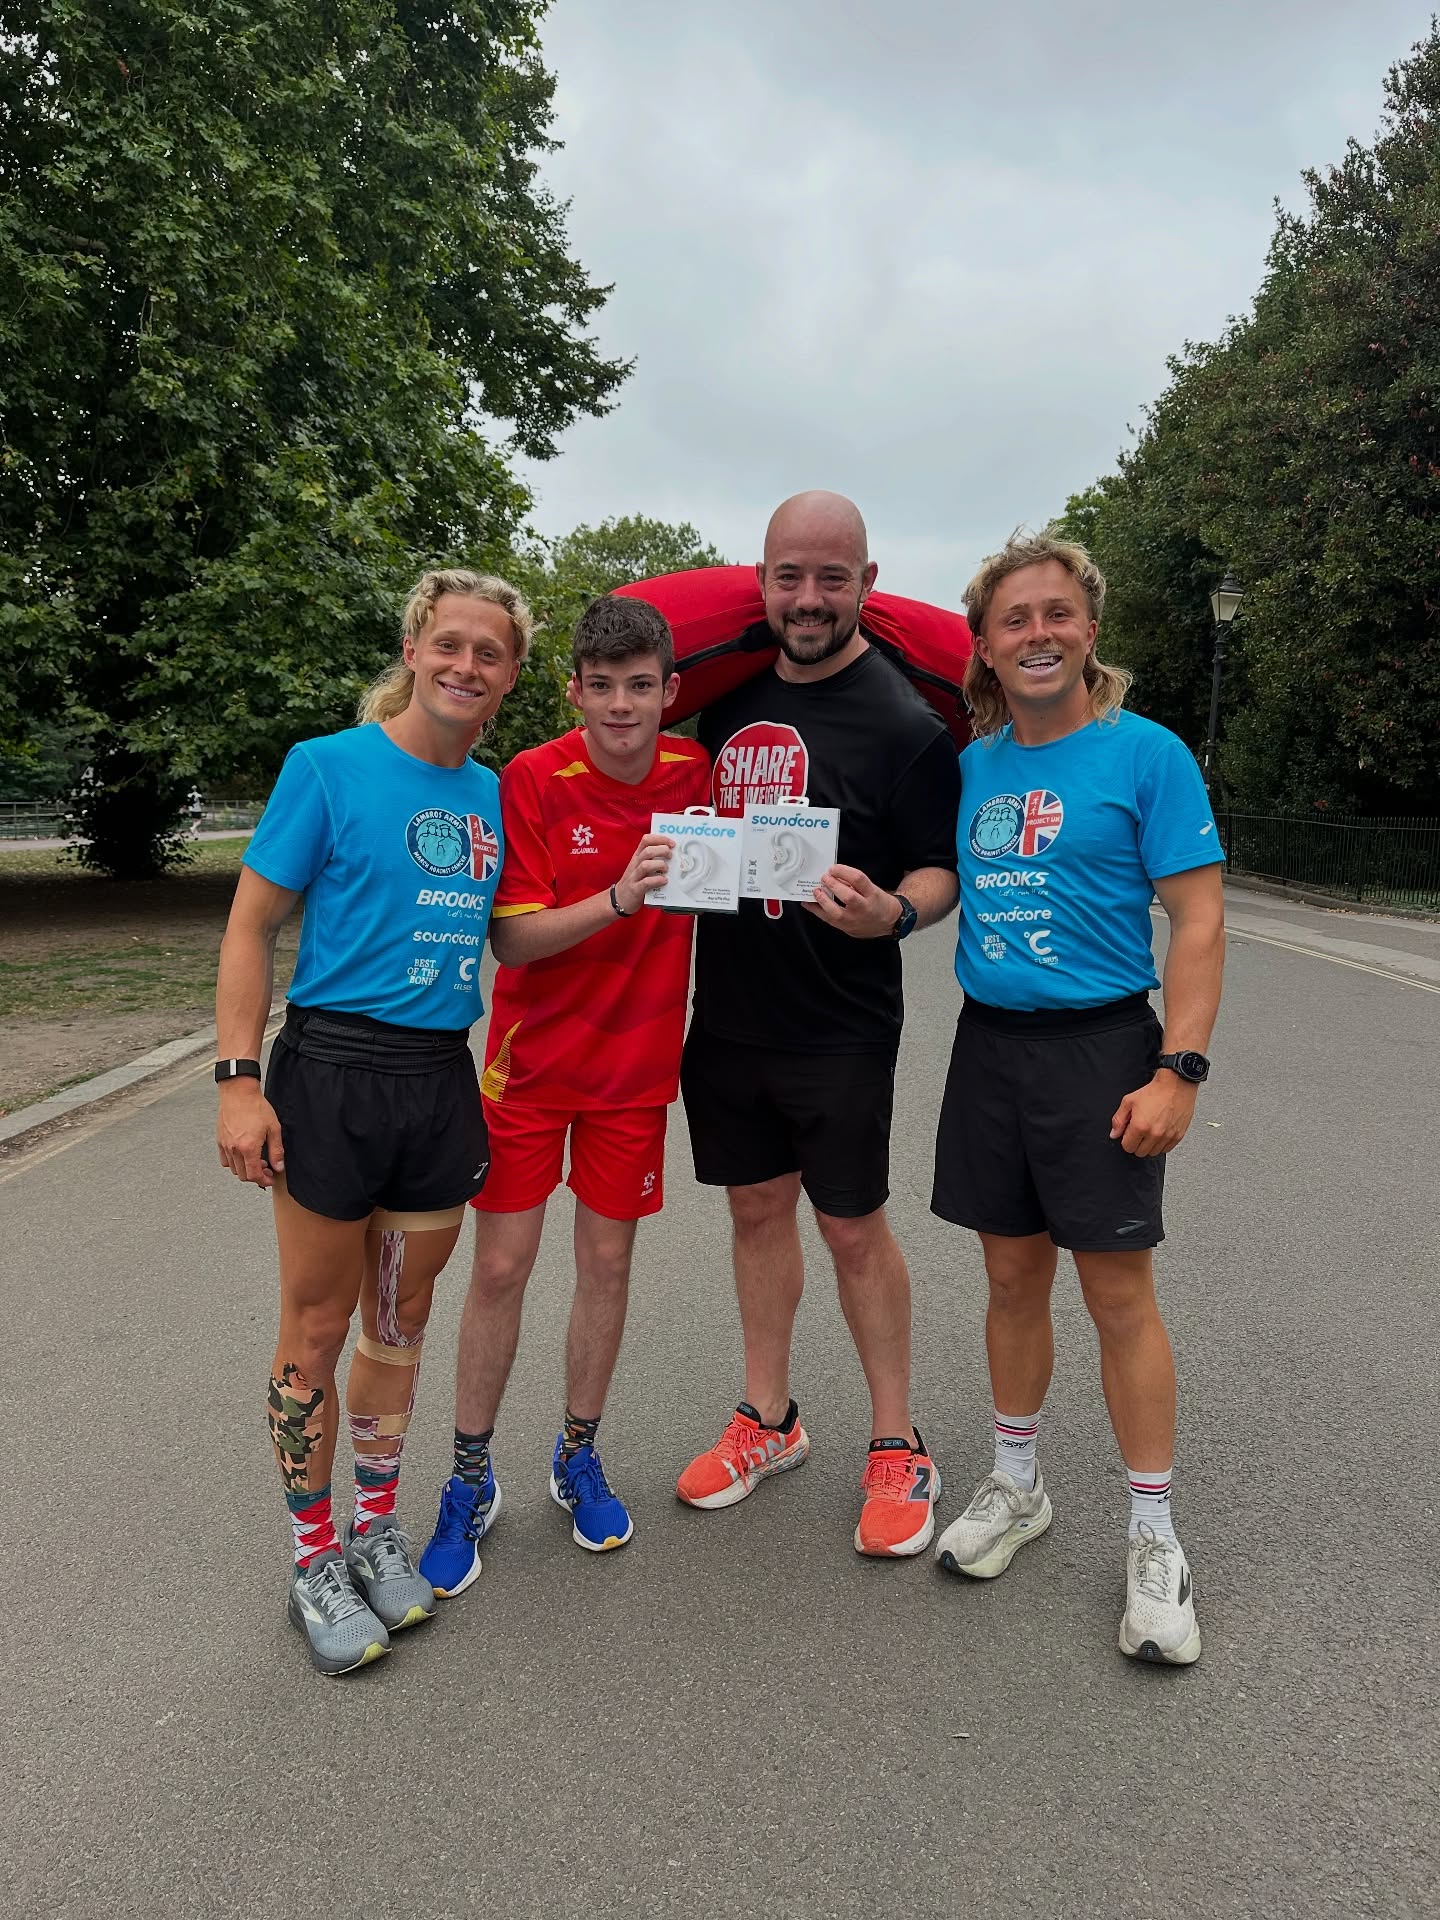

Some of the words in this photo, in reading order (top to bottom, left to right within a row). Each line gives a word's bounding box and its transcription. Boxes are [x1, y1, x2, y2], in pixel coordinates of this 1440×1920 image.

[720, 746, 800, 785] SHARE
[720, 787, 740, 808] THE
[744, 785, 792, 805] WEIGHT
[978, 796, 1006, 815] LAMBROS
[1006, 797, 1022, 810] ARMY
[412, 811, 442, 827] LAMBROS
[444, 814, 464, 830] ARMY
[752, 812, 830, 829] soundcore
[1026, 817, 1050, 826] PROJECT
[659, 822, 736, 838] soundcore
[473, 844, 492, 852] PROJECT
[980, 848, 1000, 856] AGAINST
[1001, 834, 1019, 852] CANCER
[413, 851, 429, 868] MARCH
[428, 866, 451, 875] AGAINST
[452, 855, 468, 872] CANCER
[976, 871, 1050, 890] BROOKS
[416, 889, 486, 911] BROOKS
[998, 888, 1014, 897] Let's
[447, 909, 463, 918] Let's
[977, 906, 1052, 923] soundcore
[412, 928, 480, 946] soundcore
[984, 934, 1000, 944] BEST
[991, 942, 1006, 951] THE
[414, 958, 436, 968] BEST
[407, 966, 420, 976] OF
[422, 968, 440, 978] THE
[410, 976, 435, 986] BONE
